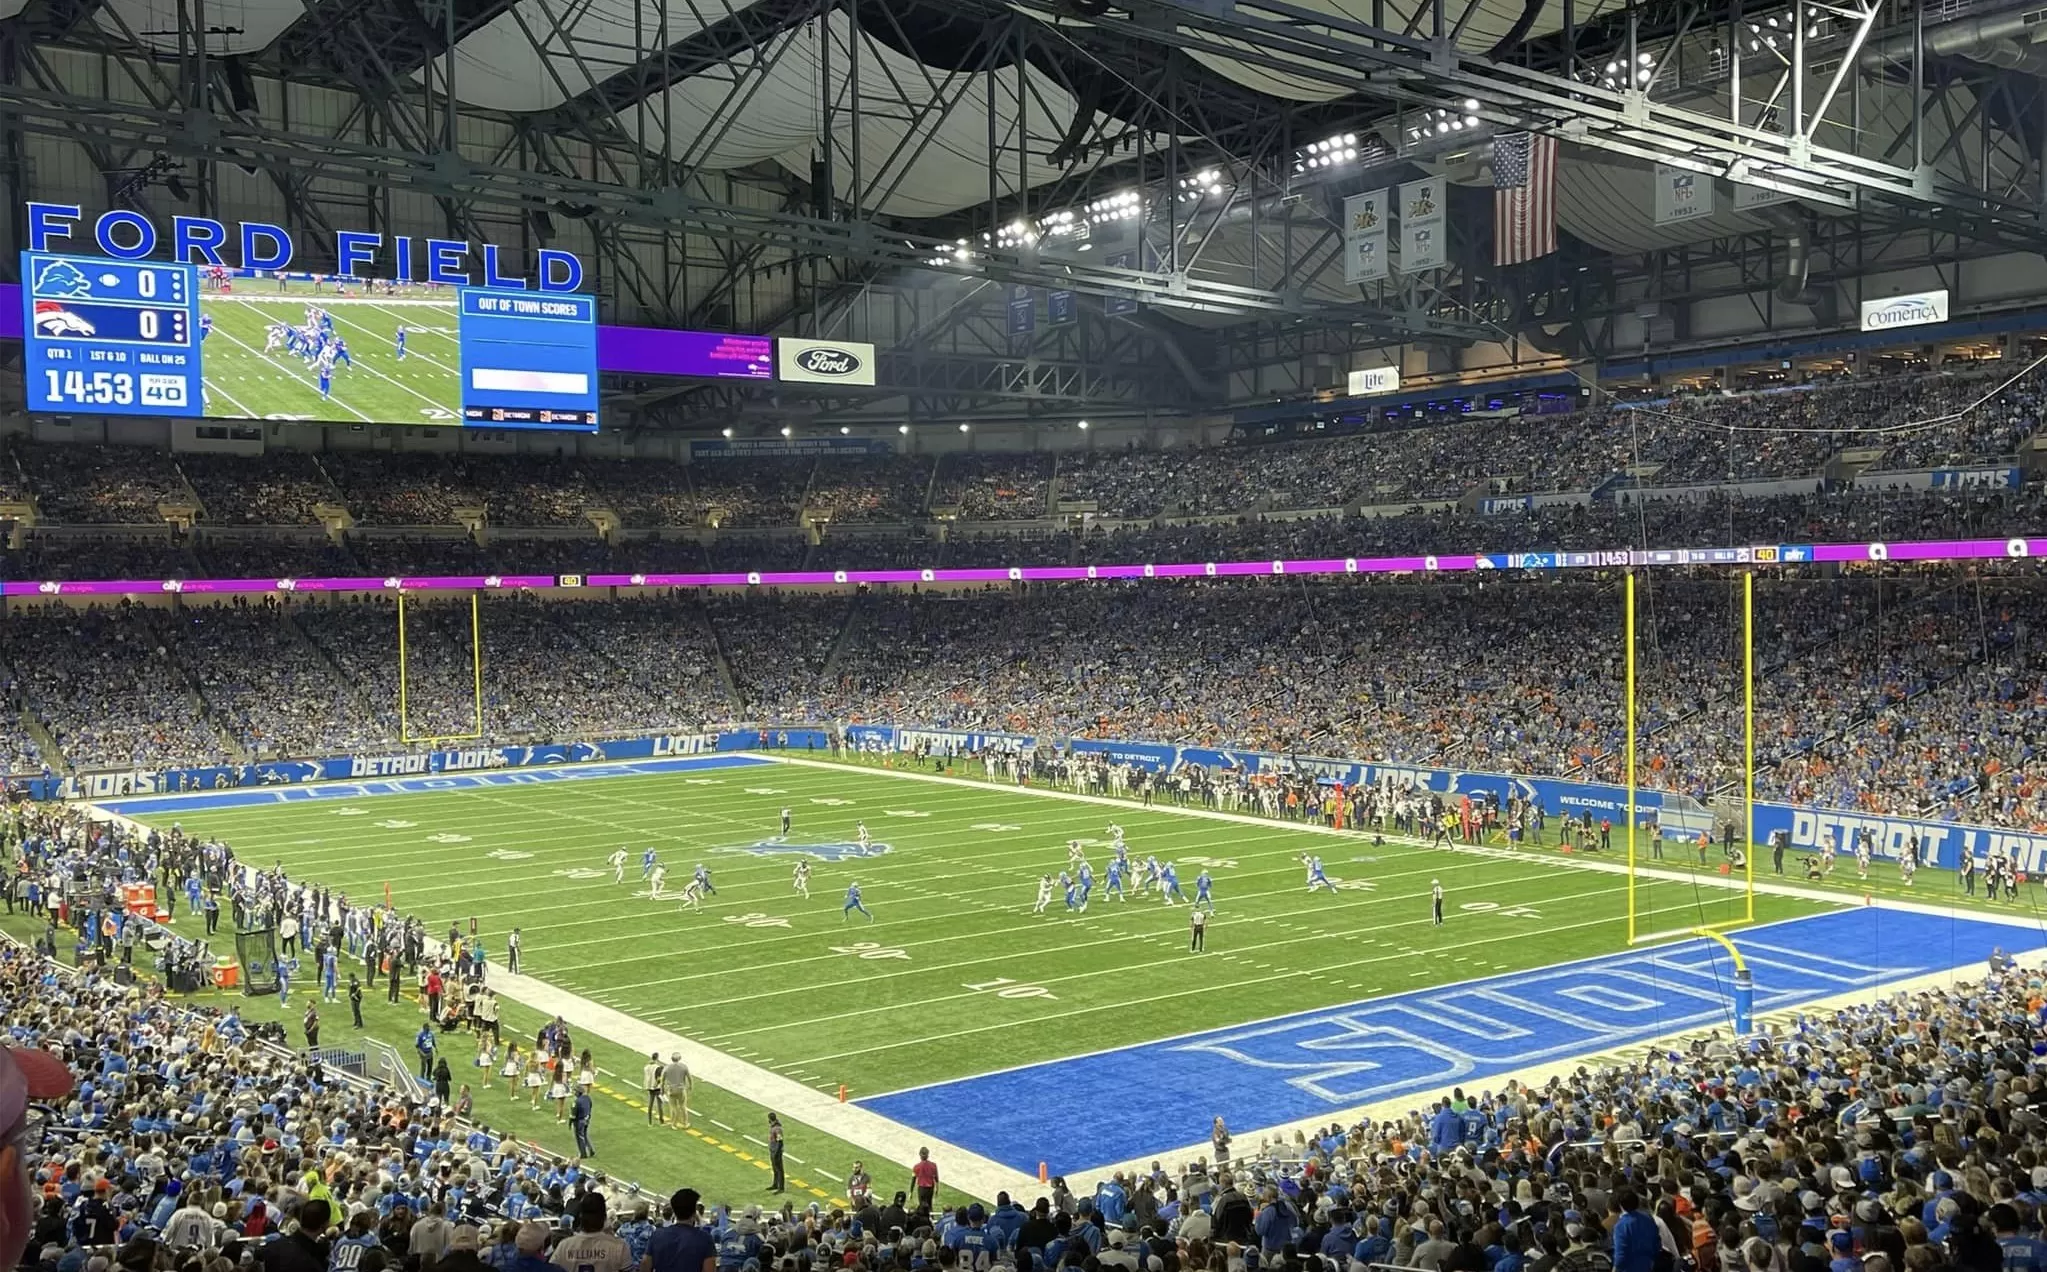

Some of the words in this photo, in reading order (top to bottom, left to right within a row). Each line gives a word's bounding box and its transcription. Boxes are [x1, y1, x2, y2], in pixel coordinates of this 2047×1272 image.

[26, 201, 294, 270] FORD
[336, 230, 584, 293] FIELD
[138, 270, 156, 297] 0
[478, 298, 498, 310] OUT
[499, 298, 512, 311] OF
[513, 300, 540, 314] TOWN
[542, 302, 578, 316] SCORES
[140, 310, 158, 339] 0
[808, 350, 848, 373] Ford
[45, 370, 134, 405] 14:53
[1364, 373, 1384, 390] Lite
[146, 386, 182, 401] 40
[1600, 551, 1628, 566] 14:53
[1758, 549, 1774, 560] 40
[39, 582, 60, 594] ally
[162, 580, 183, 593] ally
[276, 578, 296, 591] ally
[383, 576, 402, 588] ally
[1124, 754, 1161, 764] DETROIT
[1560, 796, 1614, 810] WELCOME
[722, 912, 788, 928] 30
[828, 942, 905, 960] 20
[961, 977, 1049, 999] 10
[86, 1218, 96, 1239] 7
[188, 1224, 200, 1246] 9
[336, 1244, 362, 1268] 90
